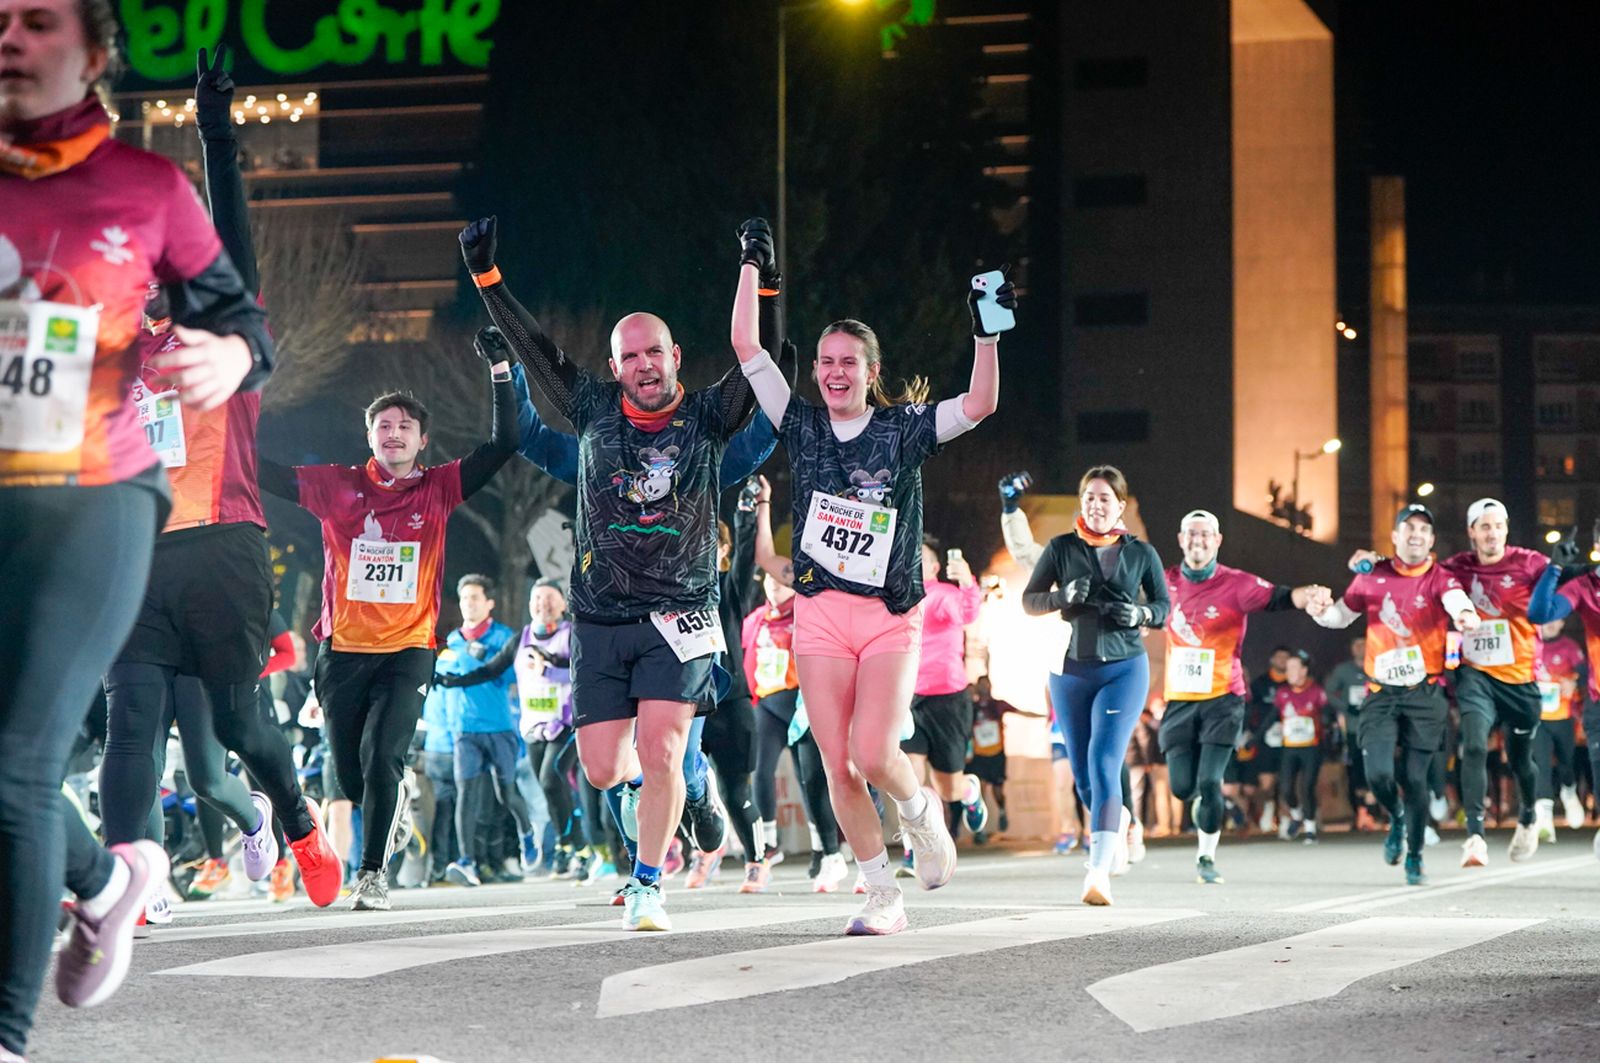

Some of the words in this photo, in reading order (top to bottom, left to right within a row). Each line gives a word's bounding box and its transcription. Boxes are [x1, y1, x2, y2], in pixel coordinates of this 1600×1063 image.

[817, 511, 835, 523] SAN
[835, 516, 863, 530] ANTÓN
[829, 505, 854, 518] NOCHE
[854, 511, 865, 520] DE
[820, 525, 875, 557] 4372
[358, 554, 372, 562] SAN
[365, 563, 403, 582] 2371
[1474, 636, 1501, 652] 2787
[1386, 664, 1415, 681] 2785
